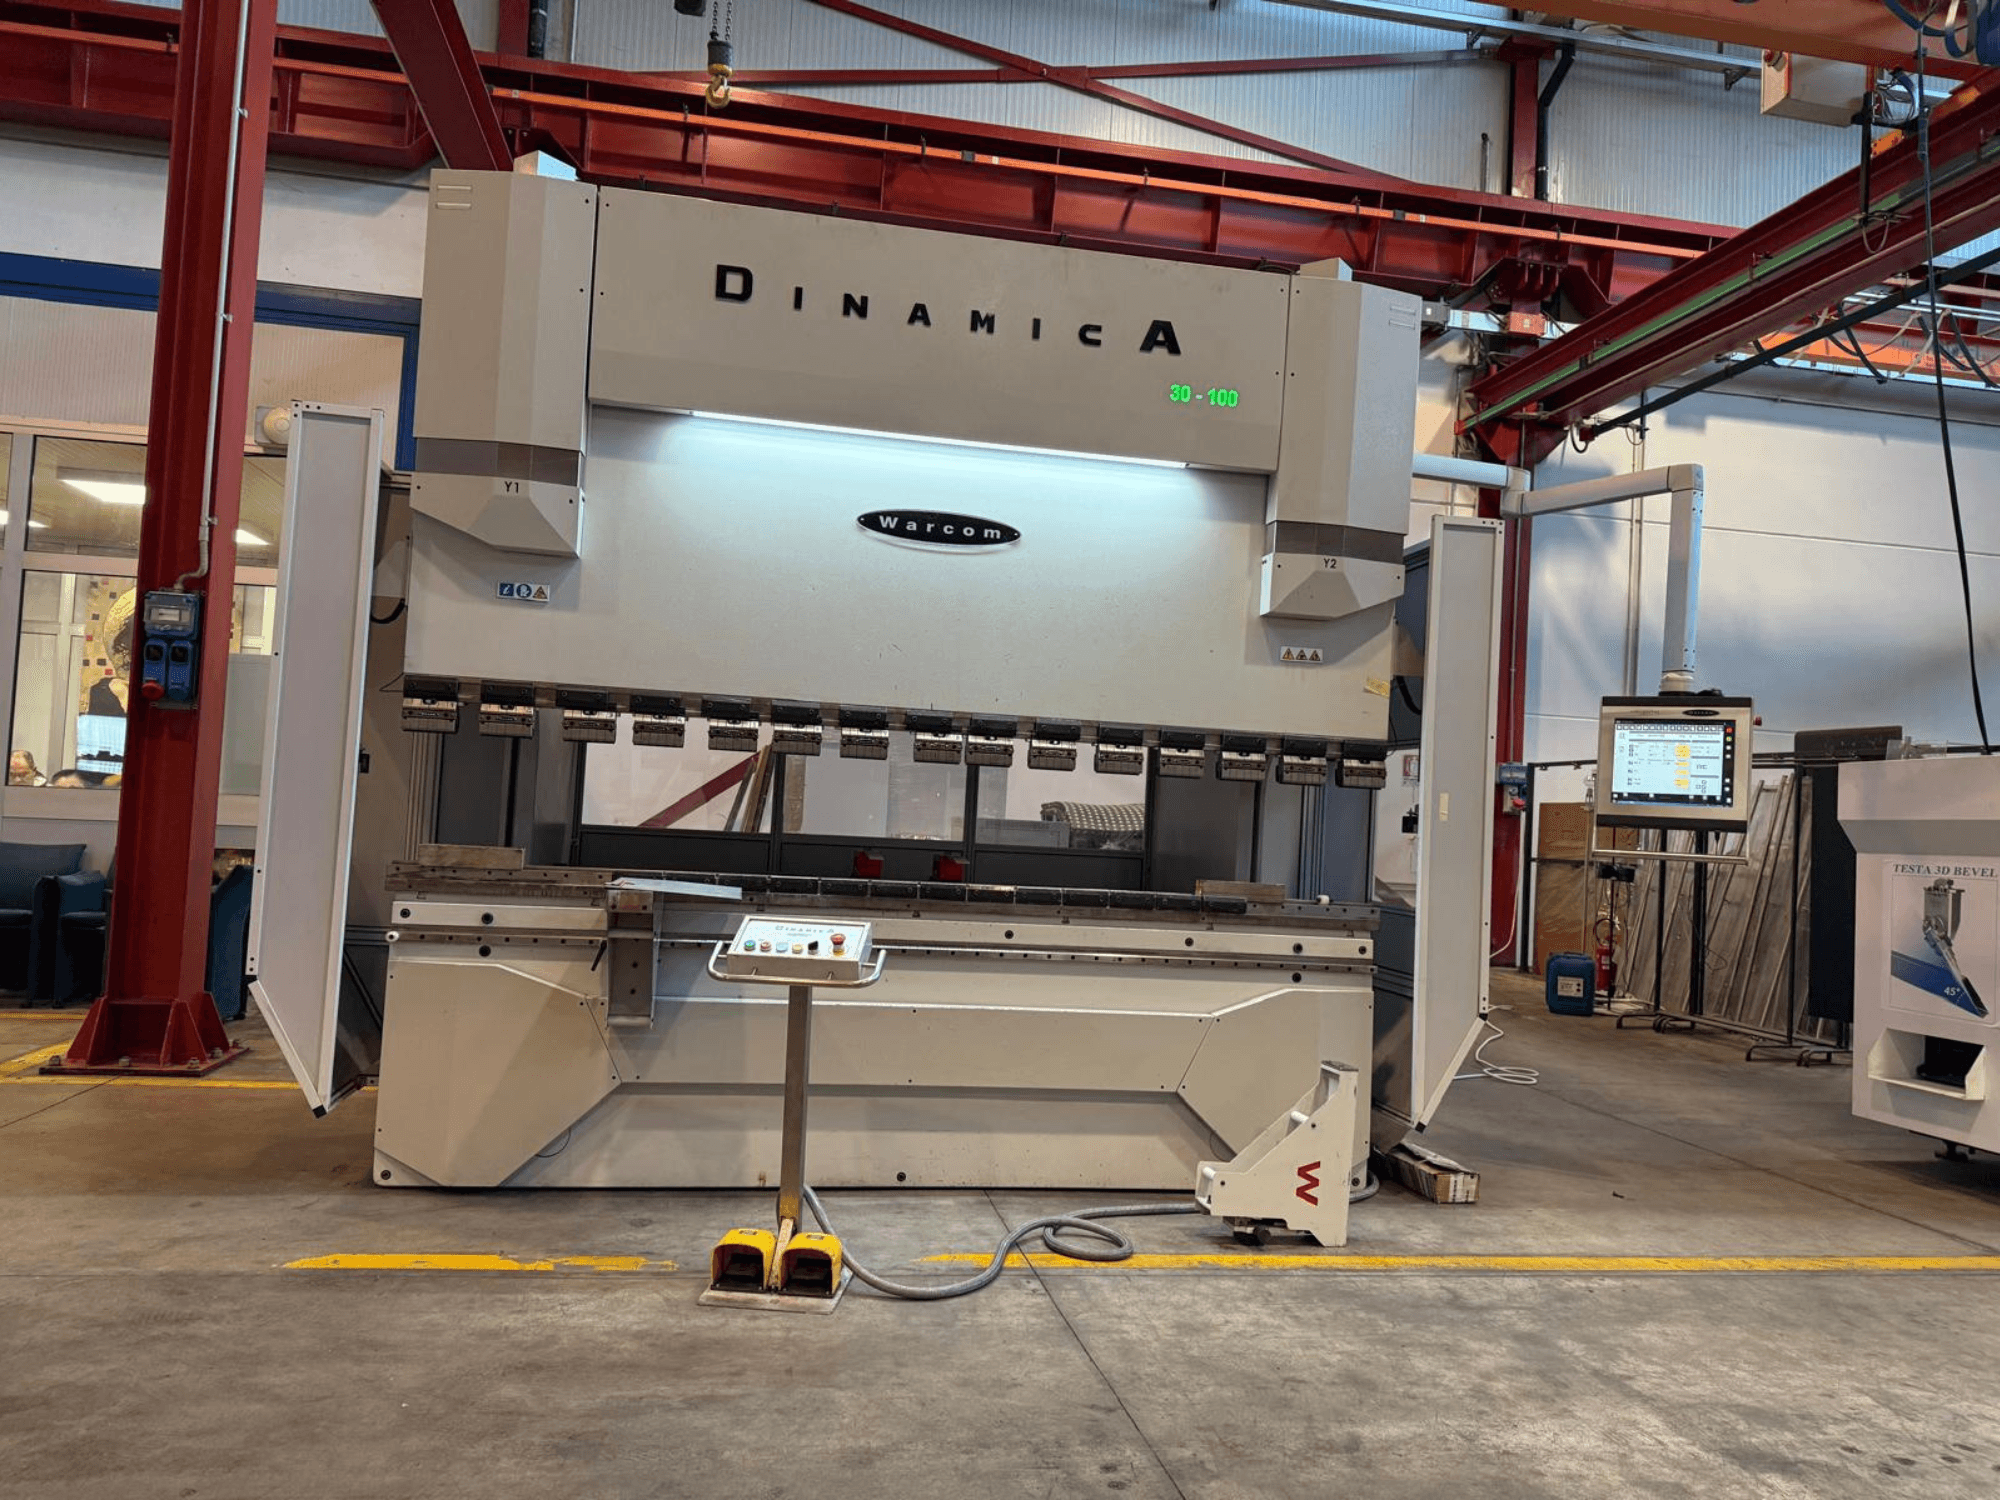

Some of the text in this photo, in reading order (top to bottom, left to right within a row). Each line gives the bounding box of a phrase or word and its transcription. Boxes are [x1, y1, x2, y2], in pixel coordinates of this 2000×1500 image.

[715, 263, 1182, 356] DINAMICA
[1169, 383, 1191, 403] 30
[1207, 387, 1239, 408] 100
[504, 480, 520, 494] Y1
[879, 514, 1001, 539] Warcom
[1323, 558, 1337, 569] Y2
[1893, 864, 1998, 878] TESTA 3D BEVEL
[1944, 986, 1961, 996] 45°
